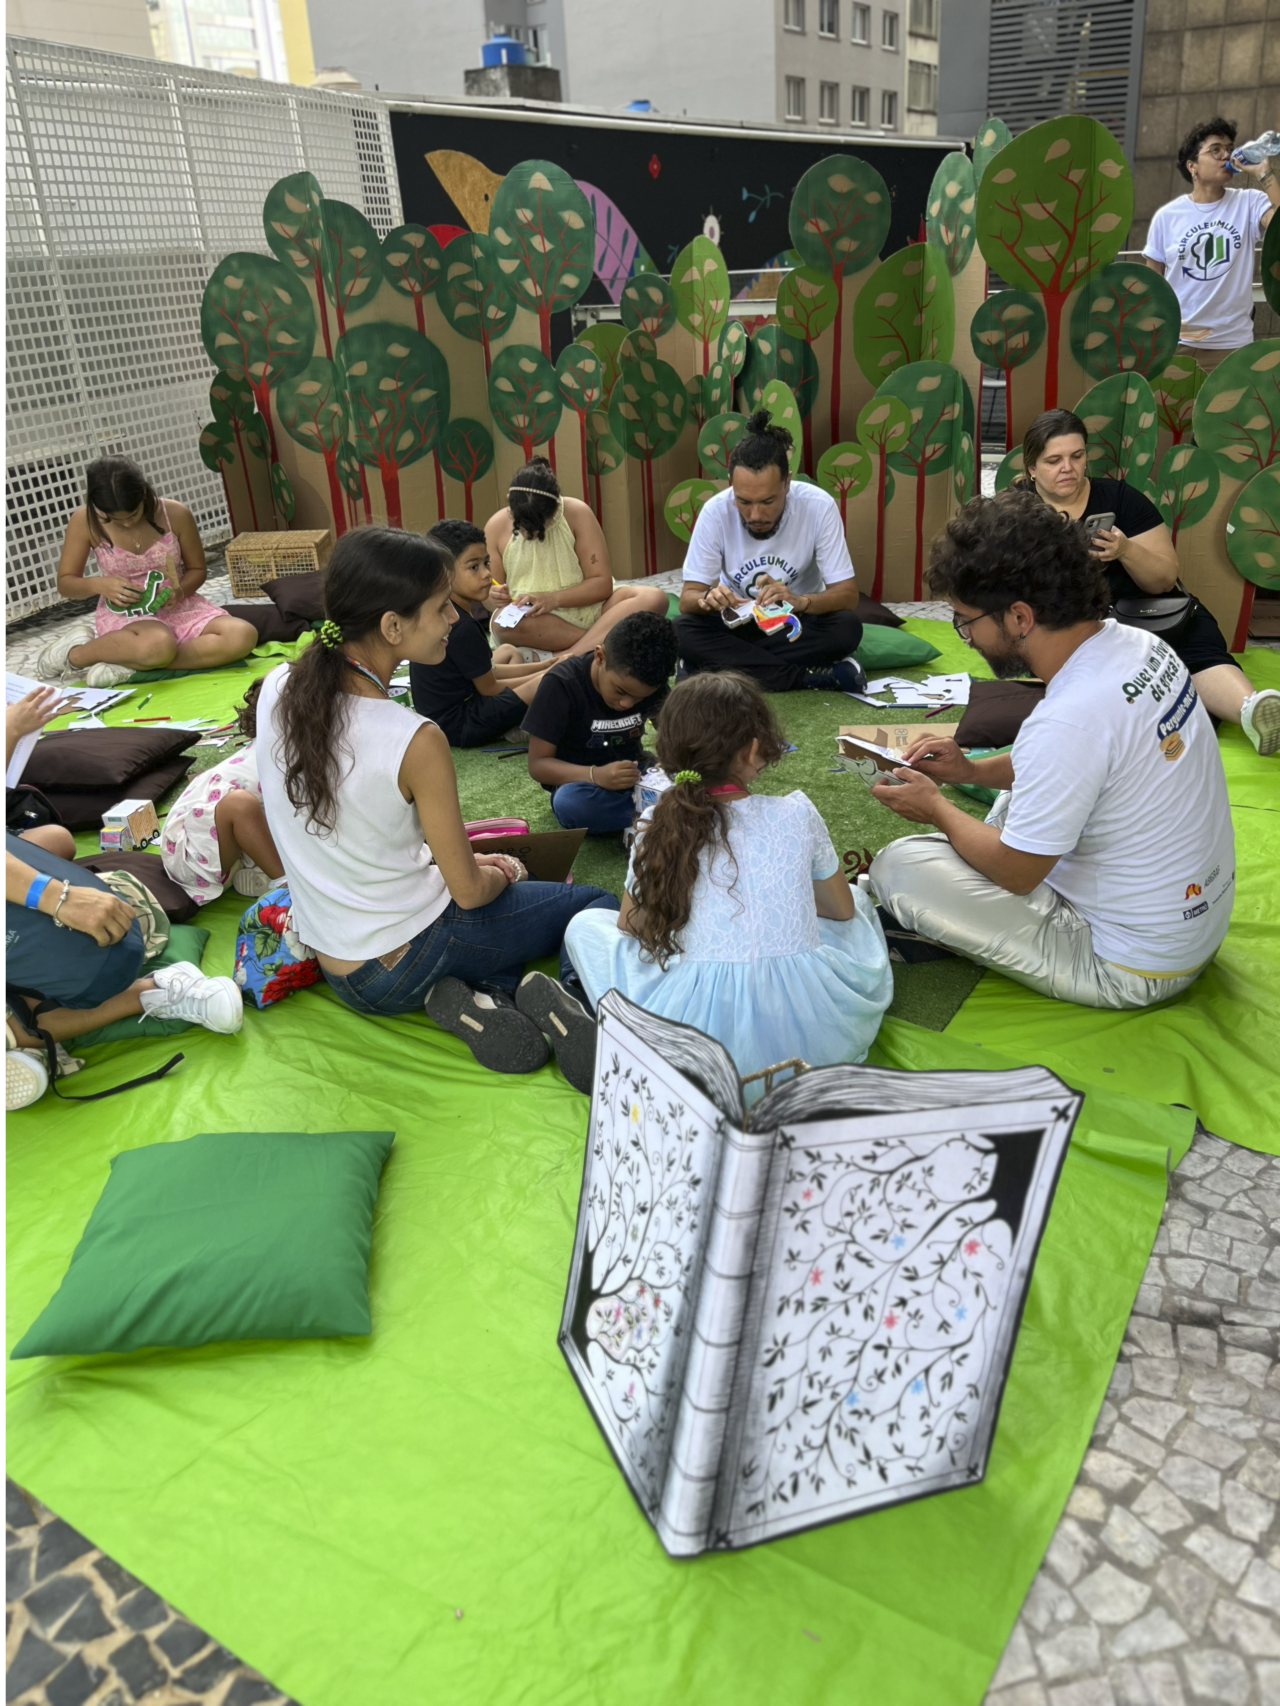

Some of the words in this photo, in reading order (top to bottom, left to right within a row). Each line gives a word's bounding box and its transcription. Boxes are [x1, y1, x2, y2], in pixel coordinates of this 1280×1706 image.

[1178, 220, 1242, 261] #CIRCULEUMLIVRO
[1122, 668, 1153, 698] Quer
[1146, 656, 1162, 673] um
[1150, 684, 1166, 702] de
[1160, 653, 1180, 693] graça?
[591, 713, 642, 731] MINECRAFT
